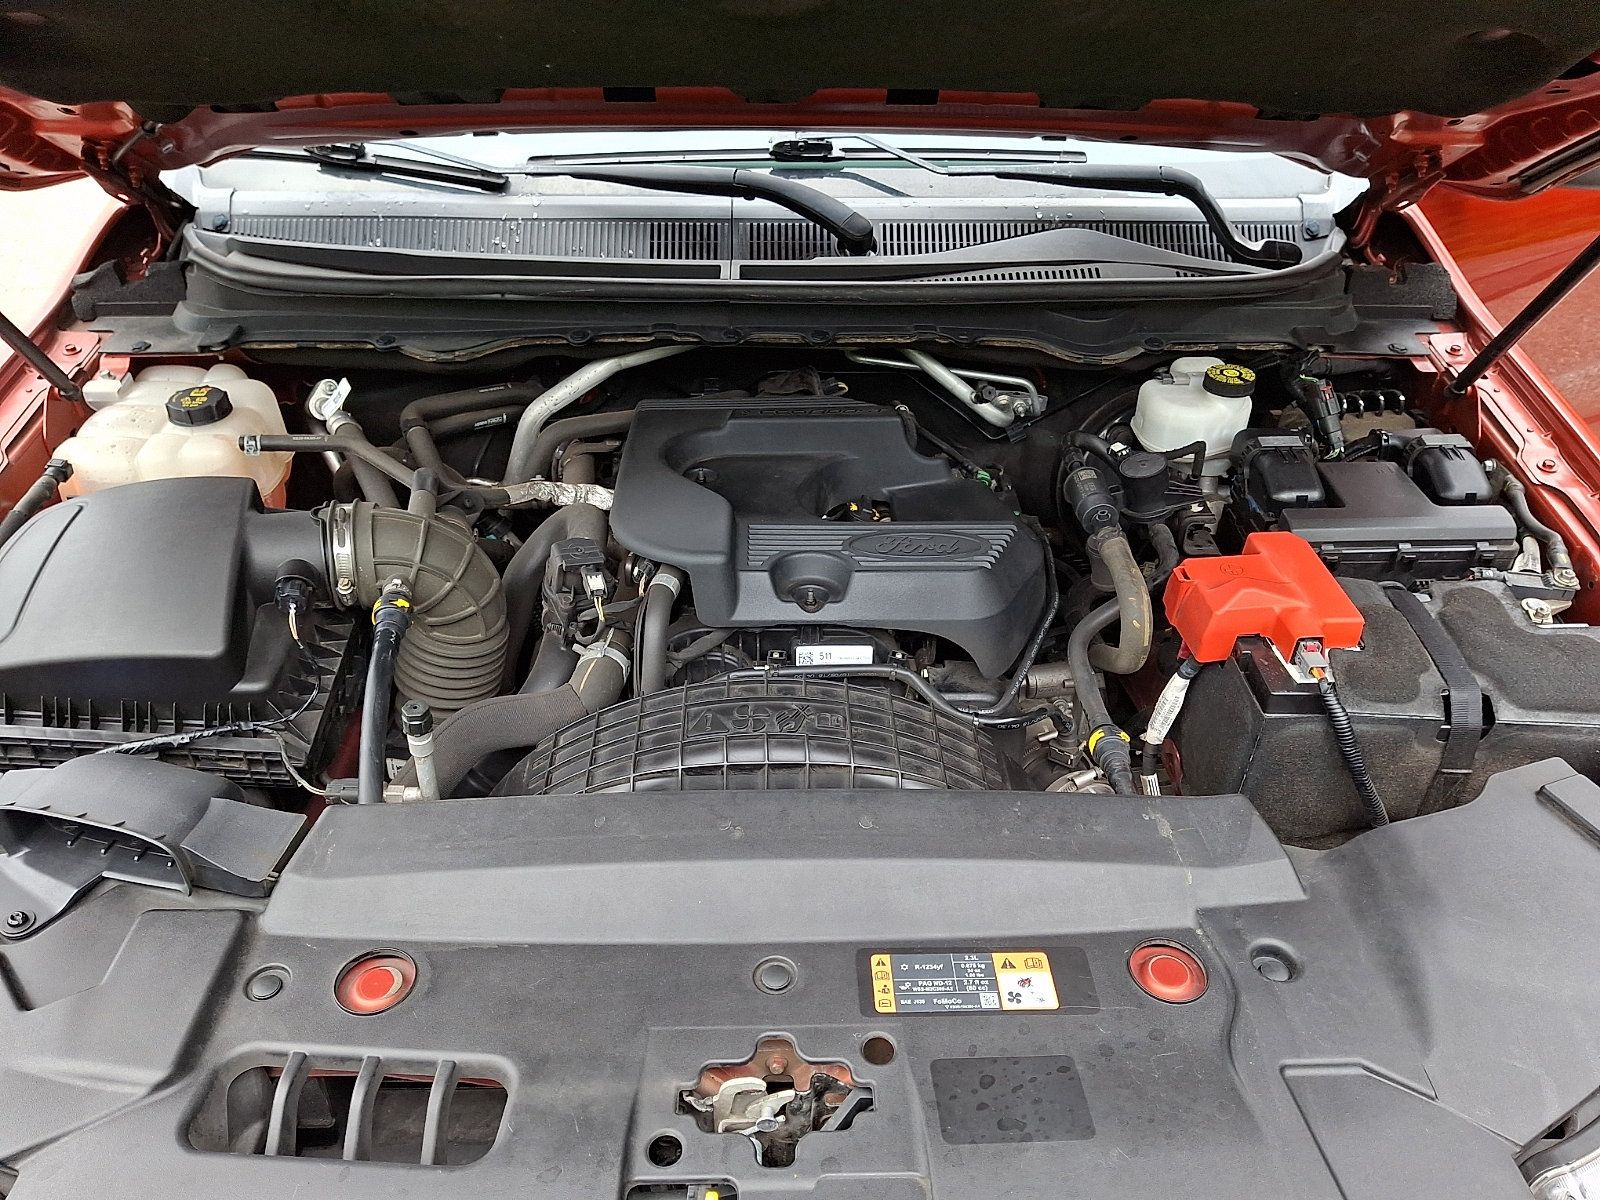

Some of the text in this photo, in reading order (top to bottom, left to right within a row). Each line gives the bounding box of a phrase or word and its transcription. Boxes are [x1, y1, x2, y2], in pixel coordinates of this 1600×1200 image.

[875, 536, 959, 554] Ford
[819, 652, 832, 660] 511
[914, 963, 944, 971] R-1234yf
